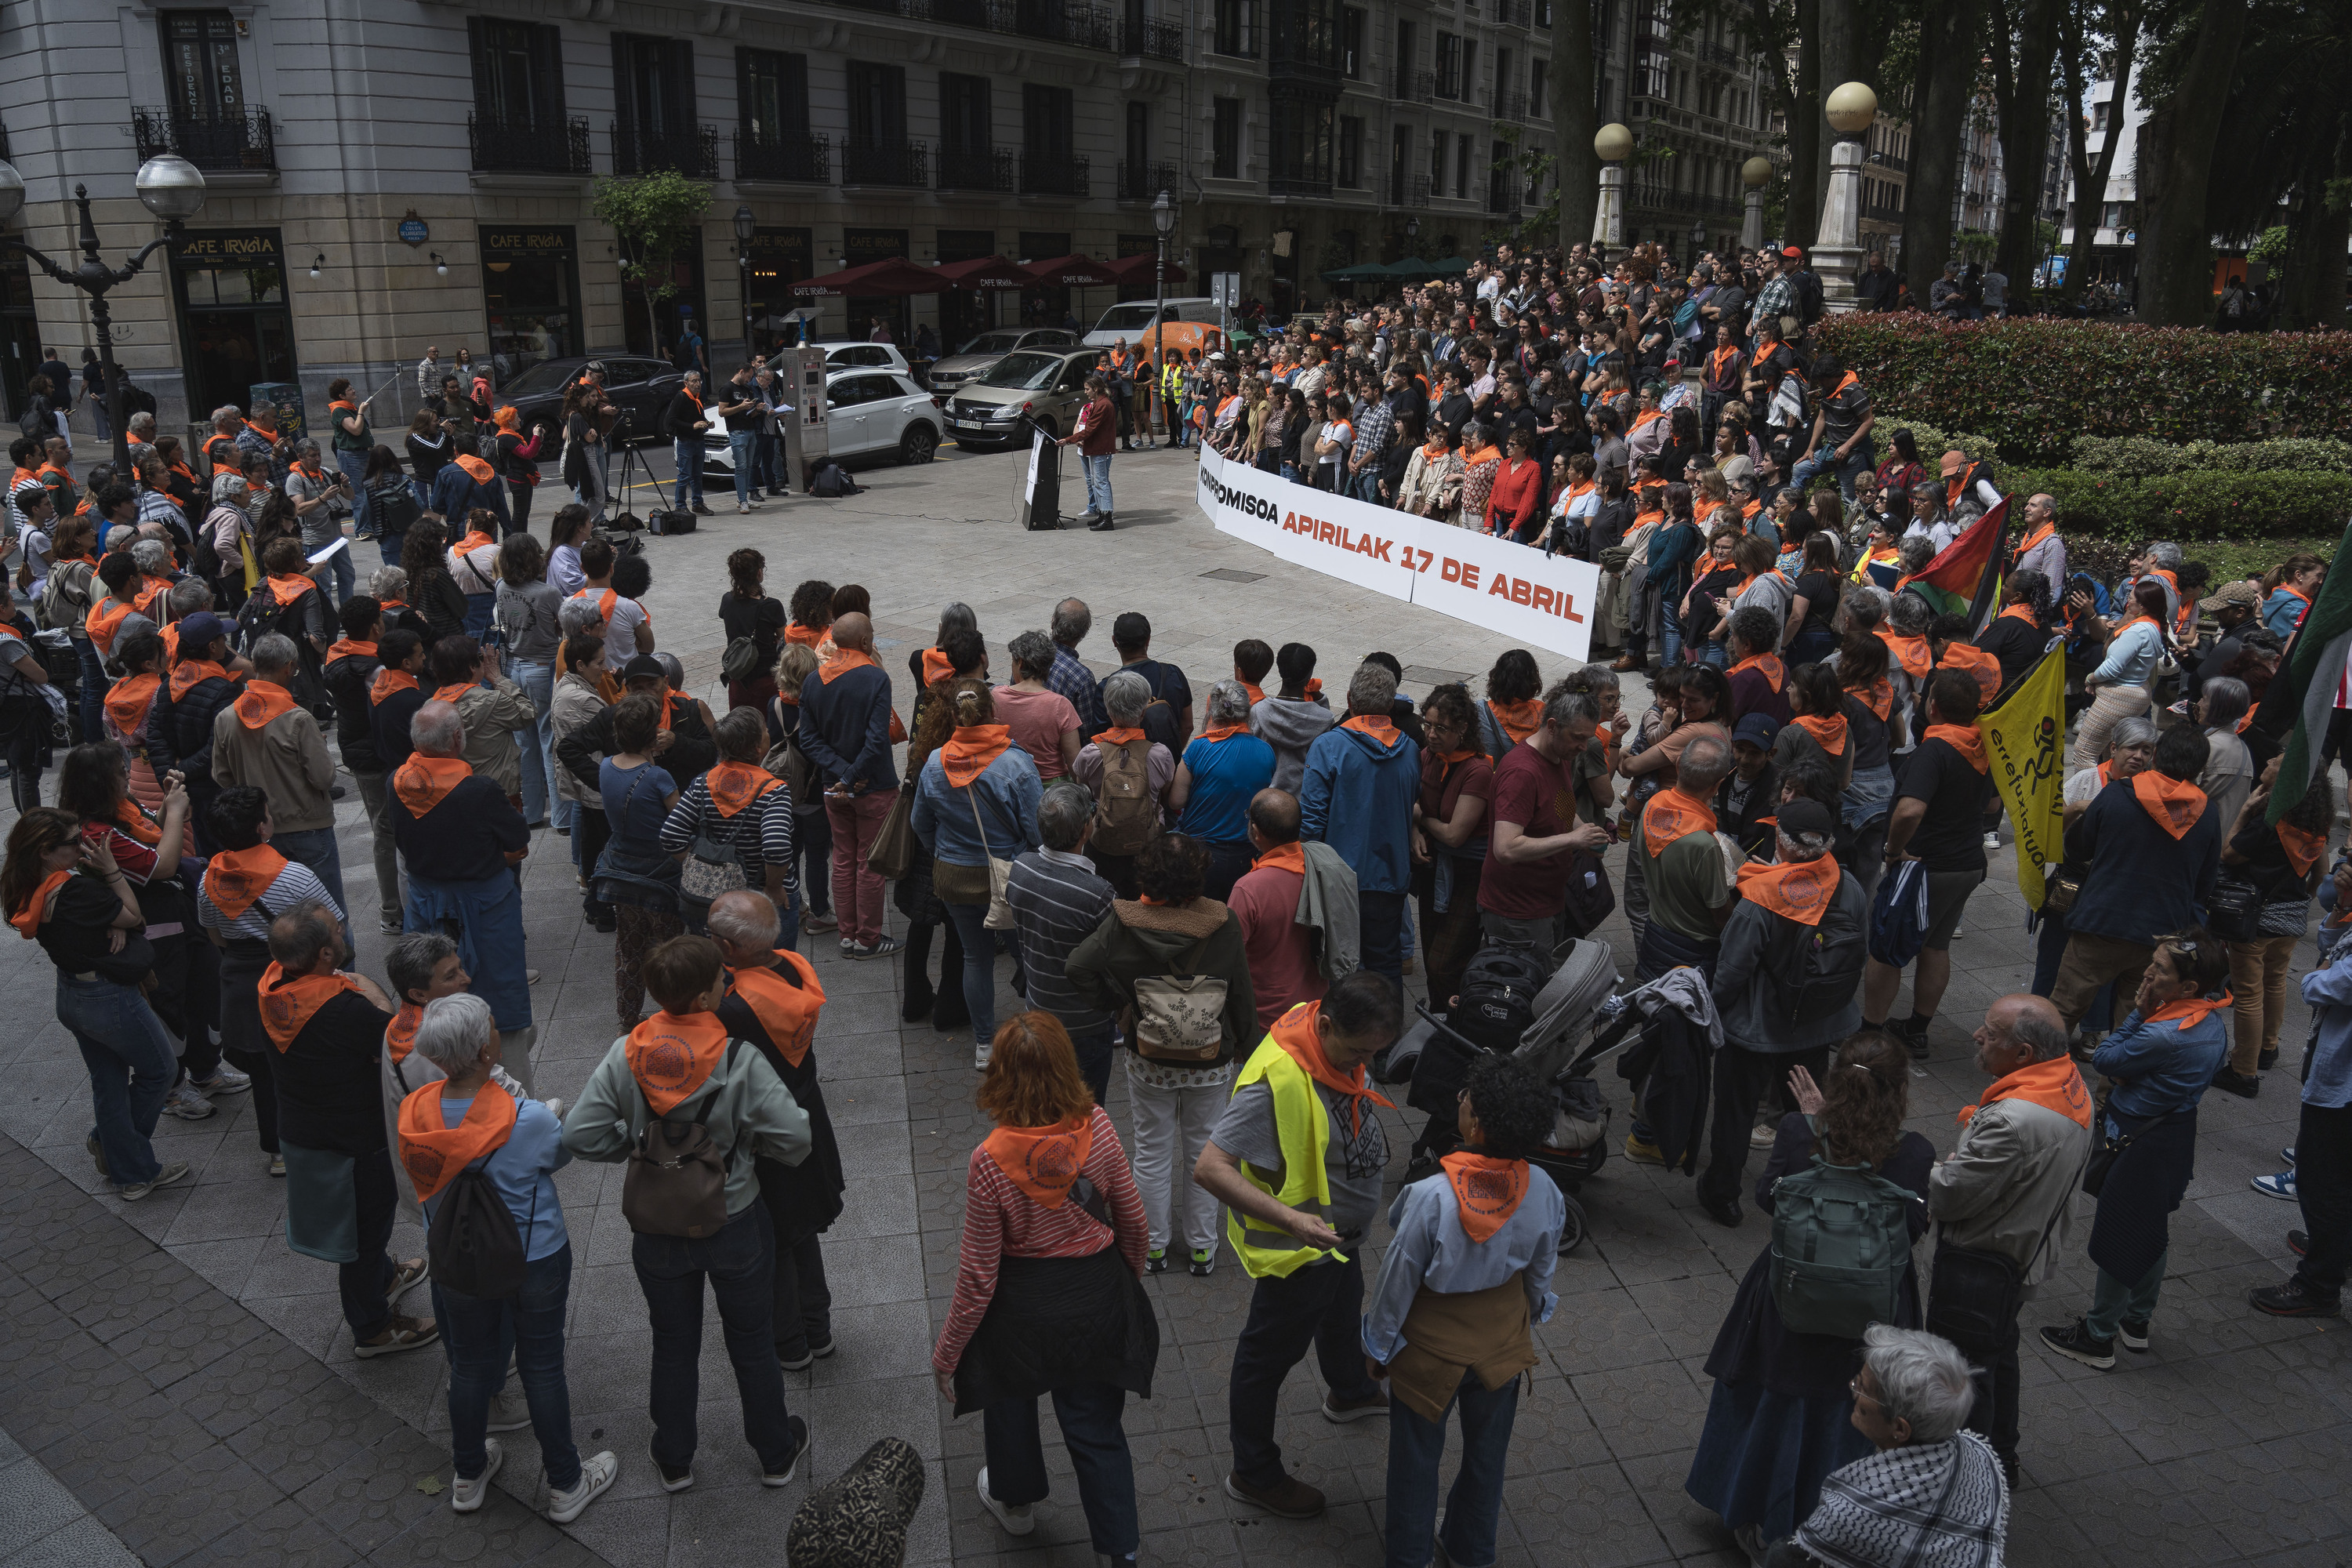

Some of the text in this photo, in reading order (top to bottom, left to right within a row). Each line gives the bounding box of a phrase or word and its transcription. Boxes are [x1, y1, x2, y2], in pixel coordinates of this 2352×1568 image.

[183, 45, 198, 119] RESIDENCIA
[221, 65, 234, 103] EDAD
[183, 239, 218, 254] AFE
[490, 234, 522, 248] CAFE
[850, 236, 873, 248] CAFE
[1118, 240, 1134, 251] CAFE
[980, 278, 996, 287] CAFE
[1062, 274, 1077, 284] CAFE
[794, 287, 810, 296] CAFE
[1200, 463, 1584, 624] KONPROMISOA APIRILAK 17 DE ABRIL
[1465, 1201, 1486, 1215] PADRÓN
